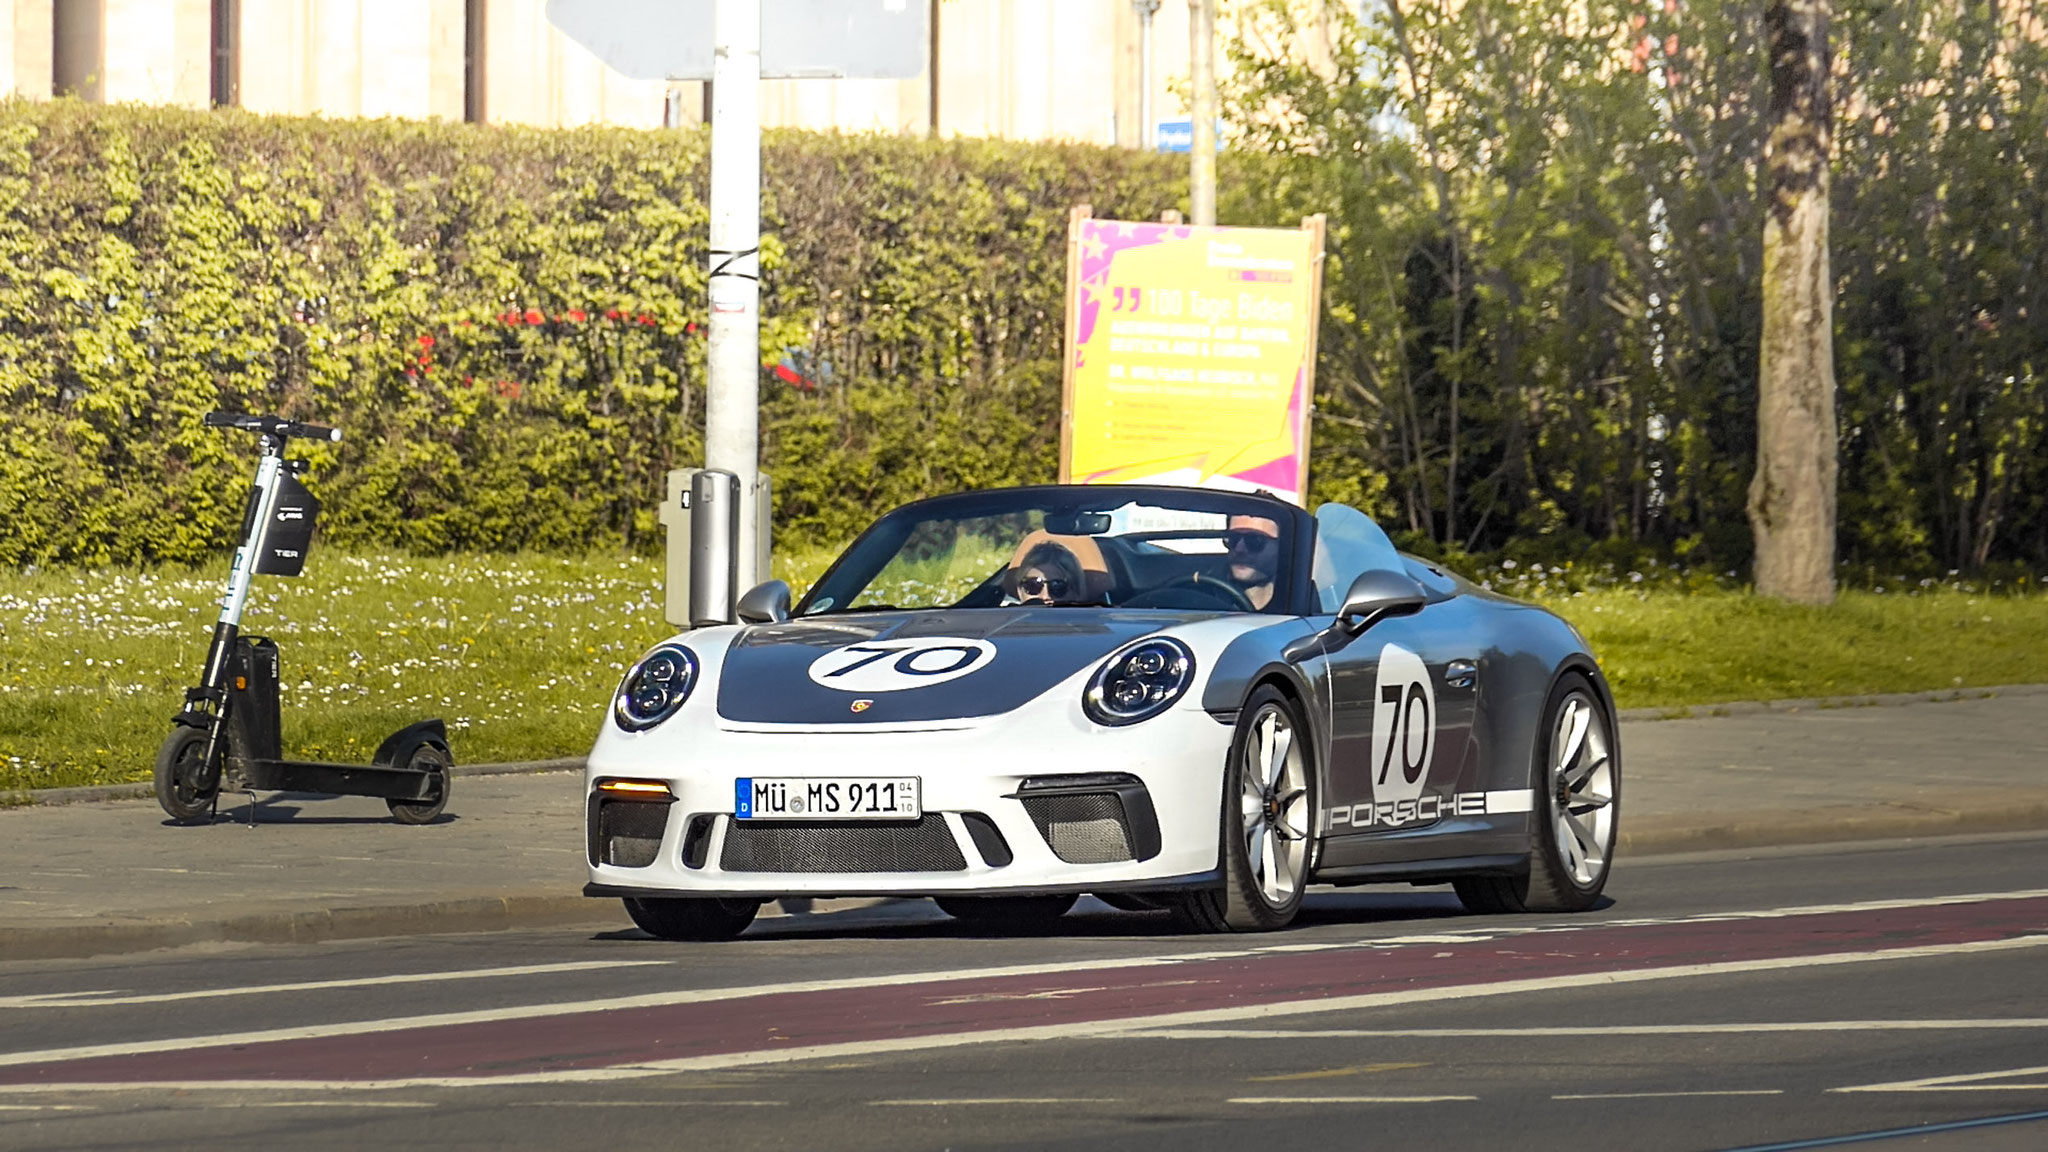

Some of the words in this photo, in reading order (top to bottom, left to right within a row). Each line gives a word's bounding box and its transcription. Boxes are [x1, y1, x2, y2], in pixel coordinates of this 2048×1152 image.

[1148, 288, 1183, 316] 100
[1189, 290, 1232, 324] Tage
[1238, 292, 1294, 321] Biden
[274, 549, 299, 558] TIER
[822, 646, 983, 678] 70
[1377, 681, 1430, 785] 70
[807, 783, 840, 813] MS
[848, 783, 898, 813] 911
[899, 782, 912, 792] 04
[741, 802, 748, 813] D
[1328, 791, 1485, 830] PORSCHE
